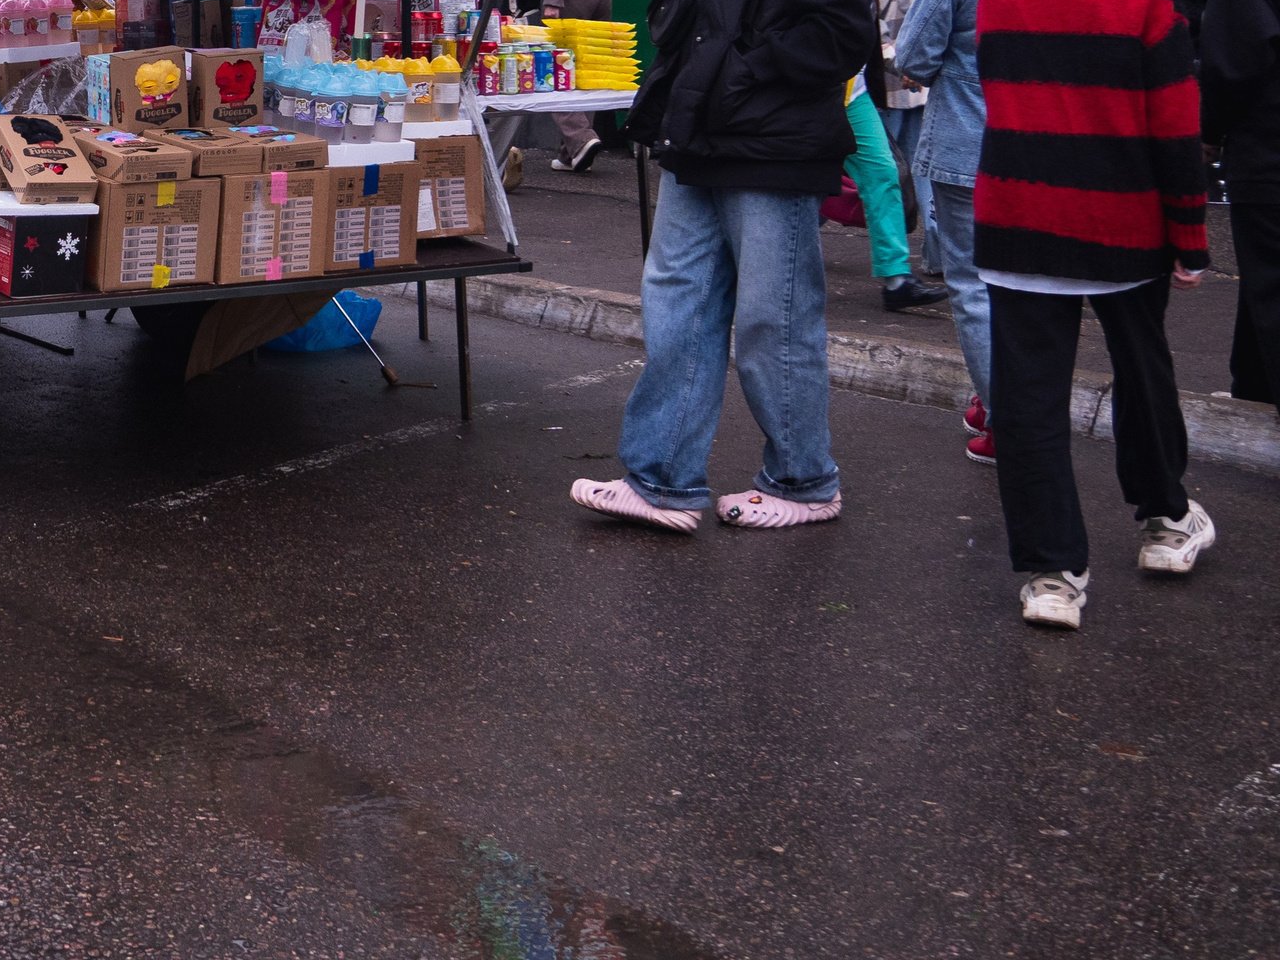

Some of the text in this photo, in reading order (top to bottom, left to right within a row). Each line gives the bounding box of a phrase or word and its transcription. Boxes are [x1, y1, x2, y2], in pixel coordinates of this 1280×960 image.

[141, 107, 178, 119] FUGGLER
[218, 108, 254, 118] FUGGLER
[28, 146, 71, 156] FUGGLER
